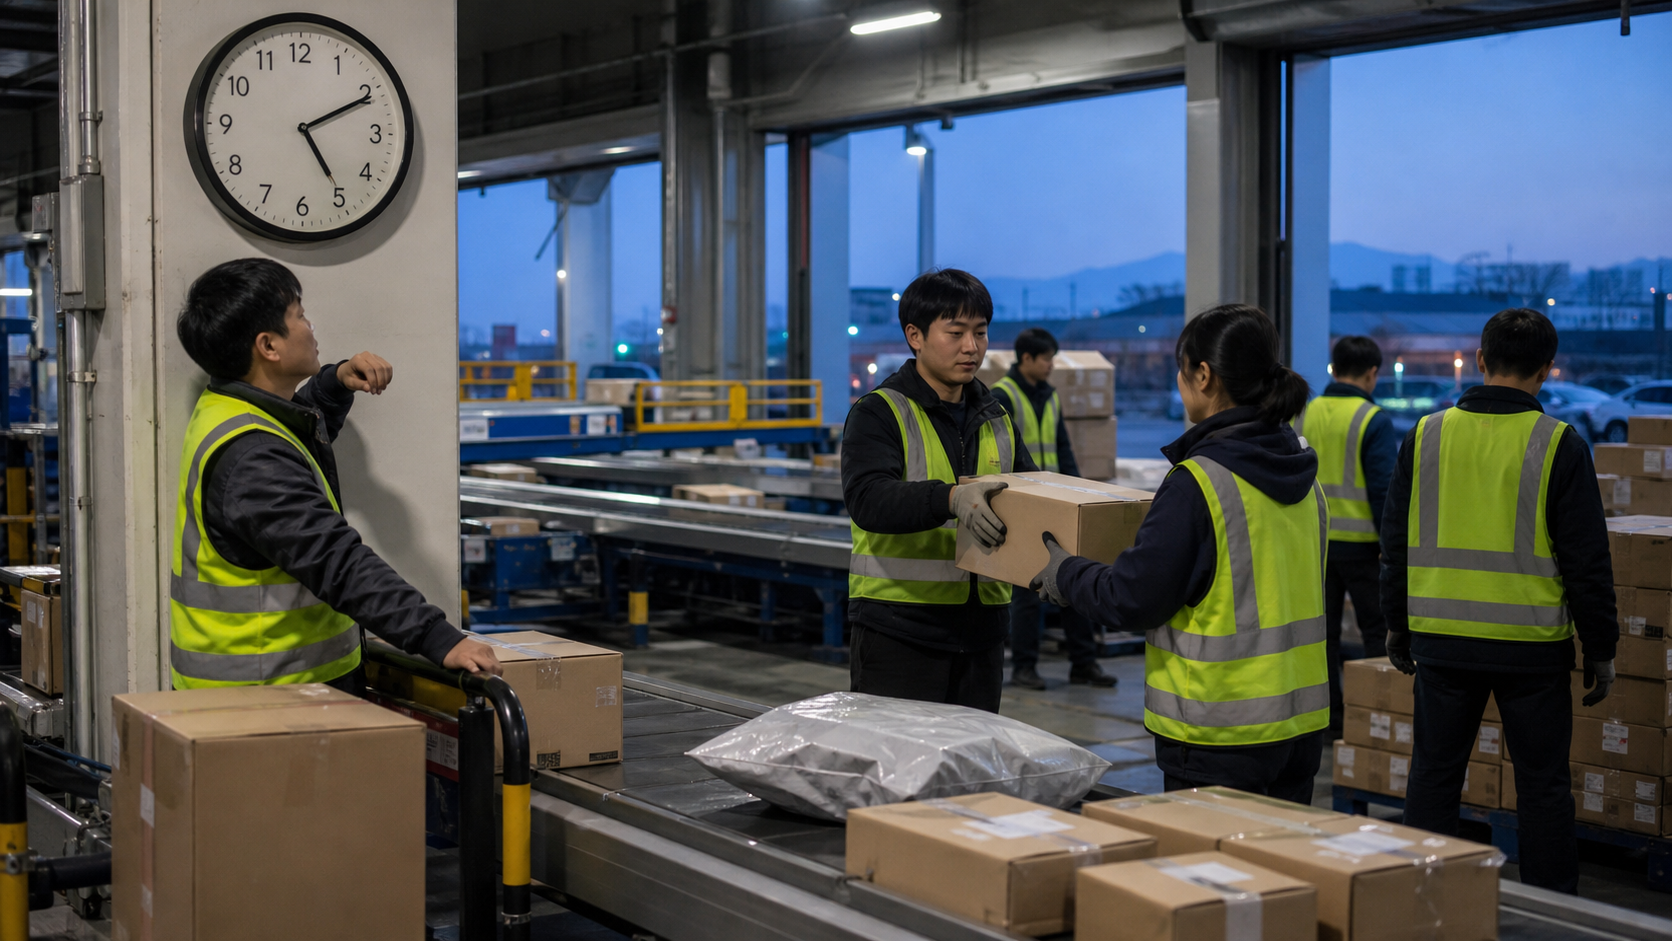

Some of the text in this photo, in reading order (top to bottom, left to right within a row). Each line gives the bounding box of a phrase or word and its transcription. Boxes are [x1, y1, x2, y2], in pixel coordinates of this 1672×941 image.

[256, 50, 273, 70] 11
[289, 42, 311, 63] 12
[333, 55, 340, 75] 1
[227, 75, 249, 96] 10
[359, 84, 372, 104] 2
[219, 114, 232, 134] 9
[369, 124, 382, 143] 3
[229, 154, 242, 175] 8
[359, 162, 372, 181] 4
[259, 184, 272, 204] 7
[333, 187, 345, 207] 5
[296, 196, 309, 216] 6
